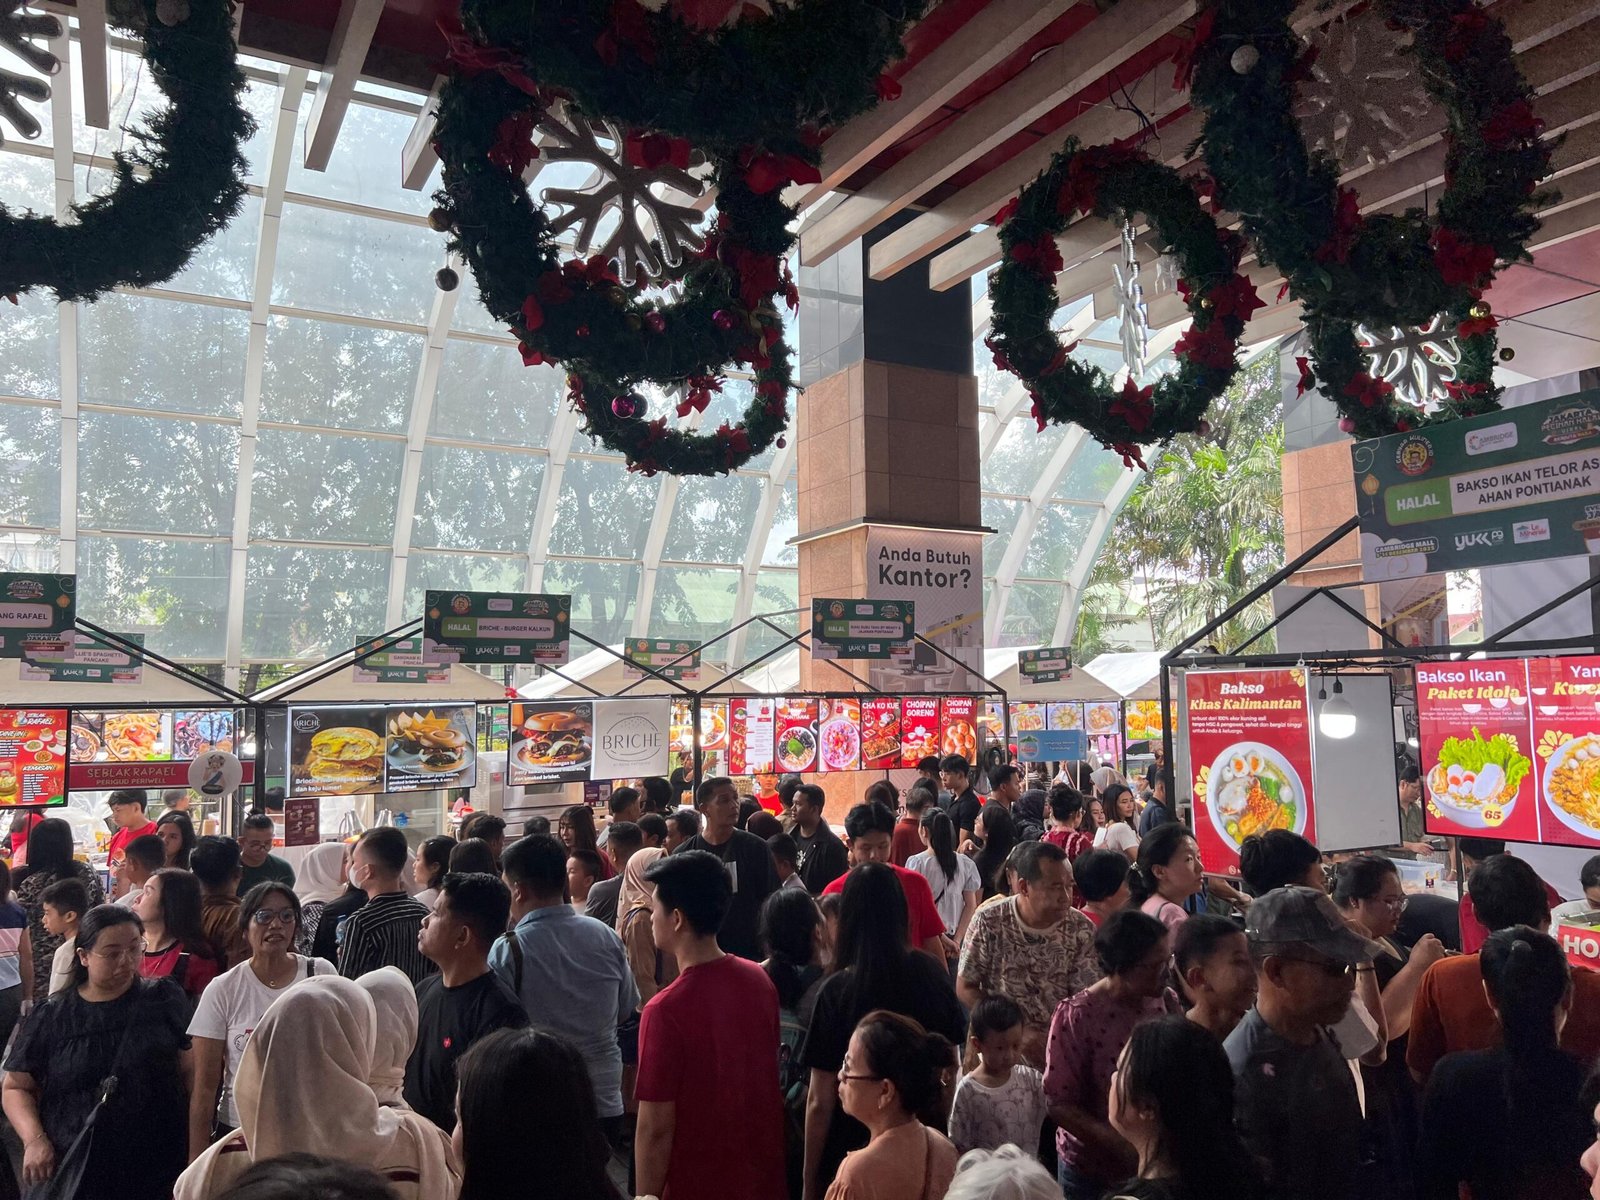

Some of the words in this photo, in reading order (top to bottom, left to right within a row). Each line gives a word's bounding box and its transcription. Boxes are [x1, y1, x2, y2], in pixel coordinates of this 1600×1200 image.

[1456, 476, 1498, 493] BAKSO
[1502, 470, 1532, 486] IKAN
[1534, 461, 1578, 479] TELOR
[1582, 458, 1600, 471] AS
[1478, 489, 1512, 504] AHAN
[1516, 475, 1592, 498] PONTIANAK
[1396, 493, 1440, 512] HALAL
[878, 546, 922, 562] Anda
[926, 549, 971, 565] Butuh
[879, 564, 972, 589] Kantor?
[1418, 671, 1466, 684] Bakso
[1470, 668, 1506, 682] Ikan
[1220, 682, 1264, 695] Bakso
[1427, 686, 1474, 700] Paket
[1476, 686, 1520, 699] Idola
[1190, 698, 1221, 710] Khas
[1222, 697, 1302, 710] Kalimantan
[602, 733, 662, 750] BRICHE
[88, 768, 132, 778] SEBLAK
[133, 767, 176, 777] RAPAEL
[1484, 810, 1501, 820] 65
[1563, 934, 1600, 958] HO
